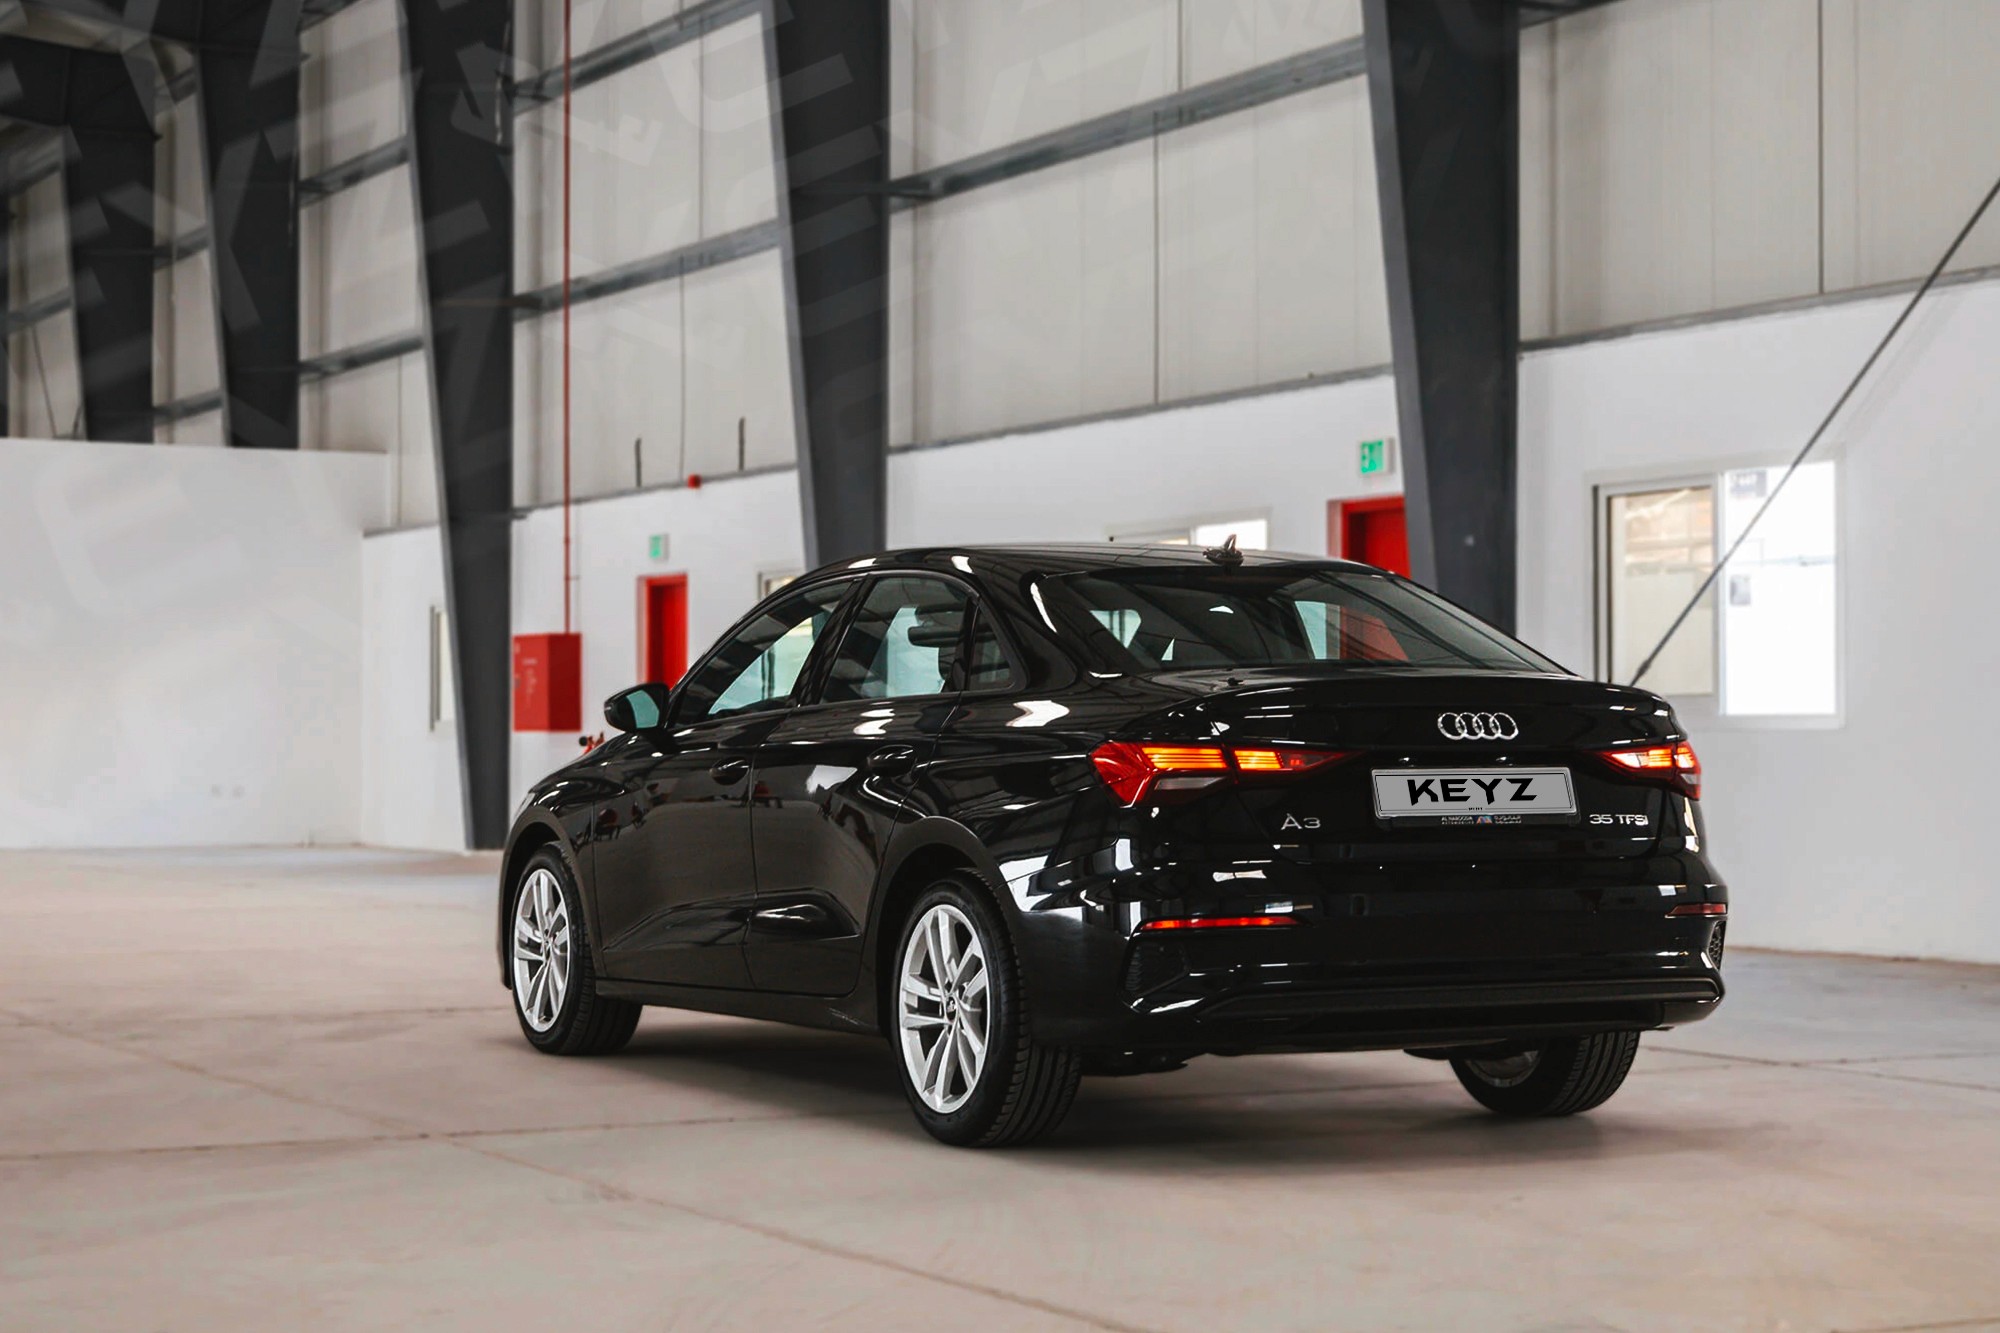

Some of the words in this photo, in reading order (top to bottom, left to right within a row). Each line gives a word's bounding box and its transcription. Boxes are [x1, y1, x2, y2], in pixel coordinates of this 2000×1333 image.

[1407, 778, 1538, 806] KEYZ
[1281, 813, 1321, 830] A3
[1589, 814, 1613, 825] 35
[1615, 814, 1649, 826] TFSI
